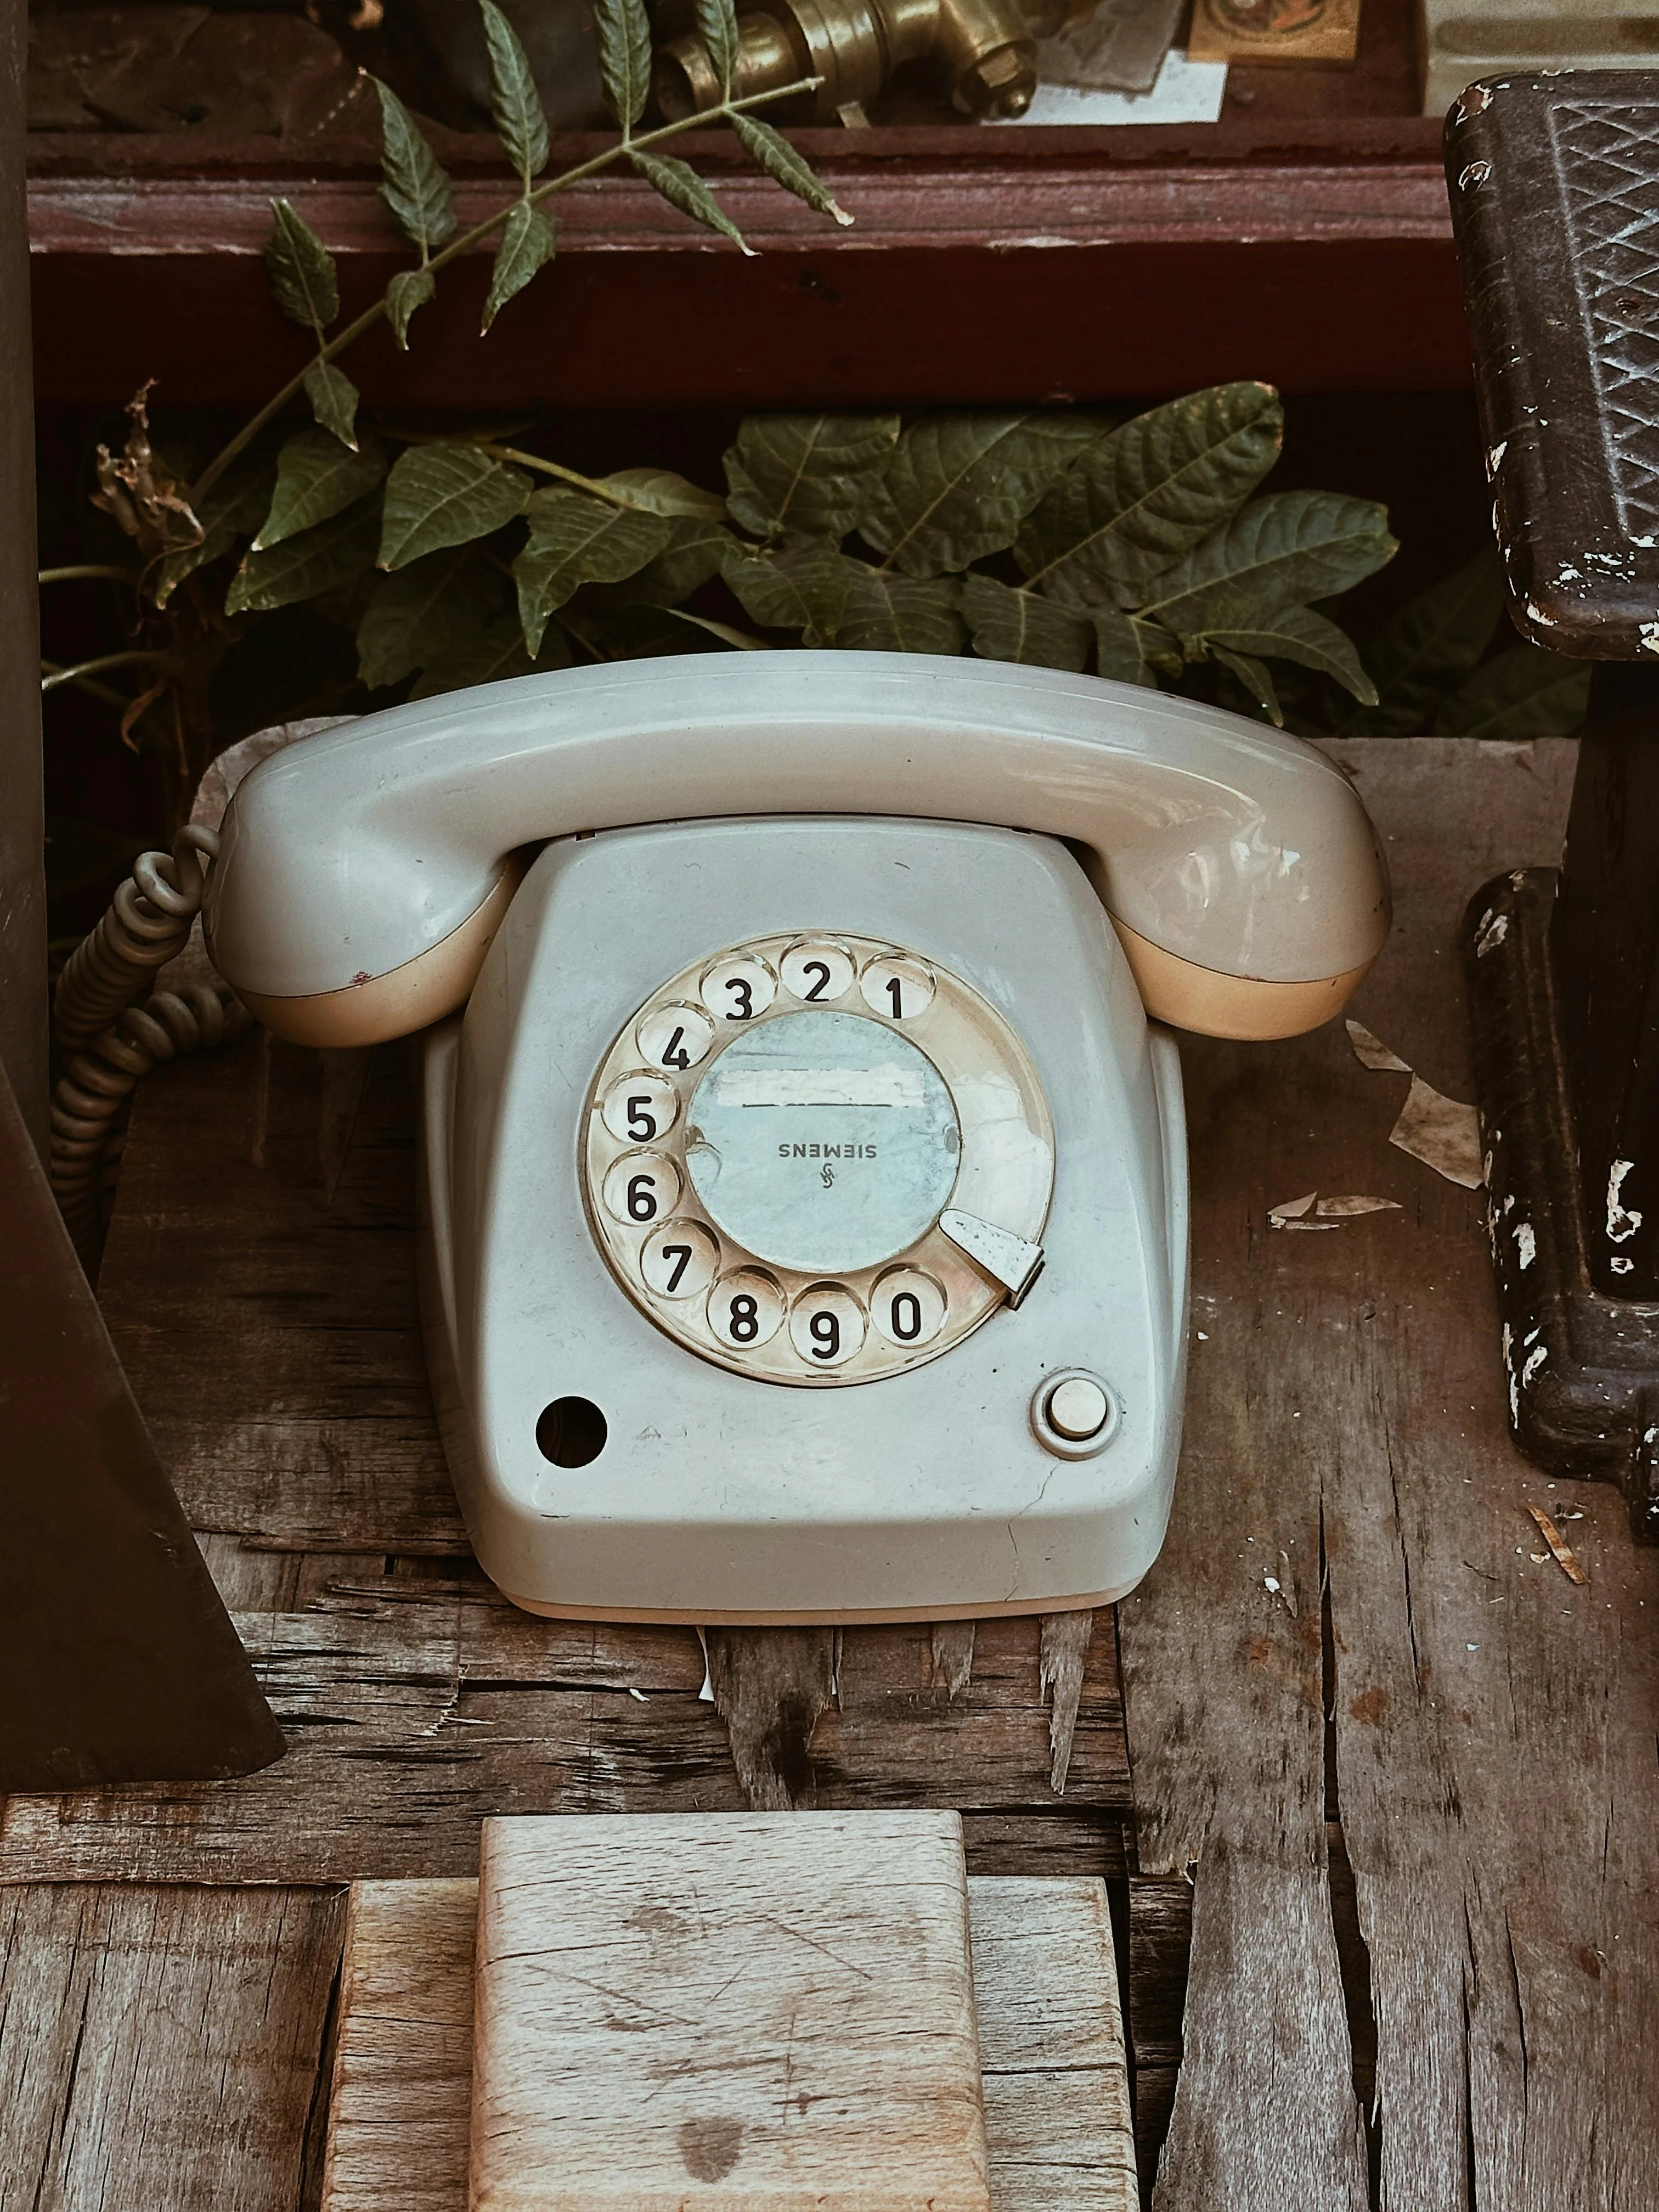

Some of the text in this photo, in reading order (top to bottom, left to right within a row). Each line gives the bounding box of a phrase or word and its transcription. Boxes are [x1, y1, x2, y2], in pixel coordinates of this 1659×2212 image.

[725, 978, 755, 1021] 3
[803, 961, 831, 1003] 2
[885, 977, 902, 1019] 1
[661, 1026, 692, 1071] 4
[627, 1096, 656, 1142] 5
[778, 1143, 877, 1159] SIEMENS
[627, 1174, 657, 1222] 6
[662, 1245, 692, 1292] 7
[729, 1294, 759, 1342] 8
[810, 1311, 840, 1359] 9
[891, 1292, 921, 1341] 0
